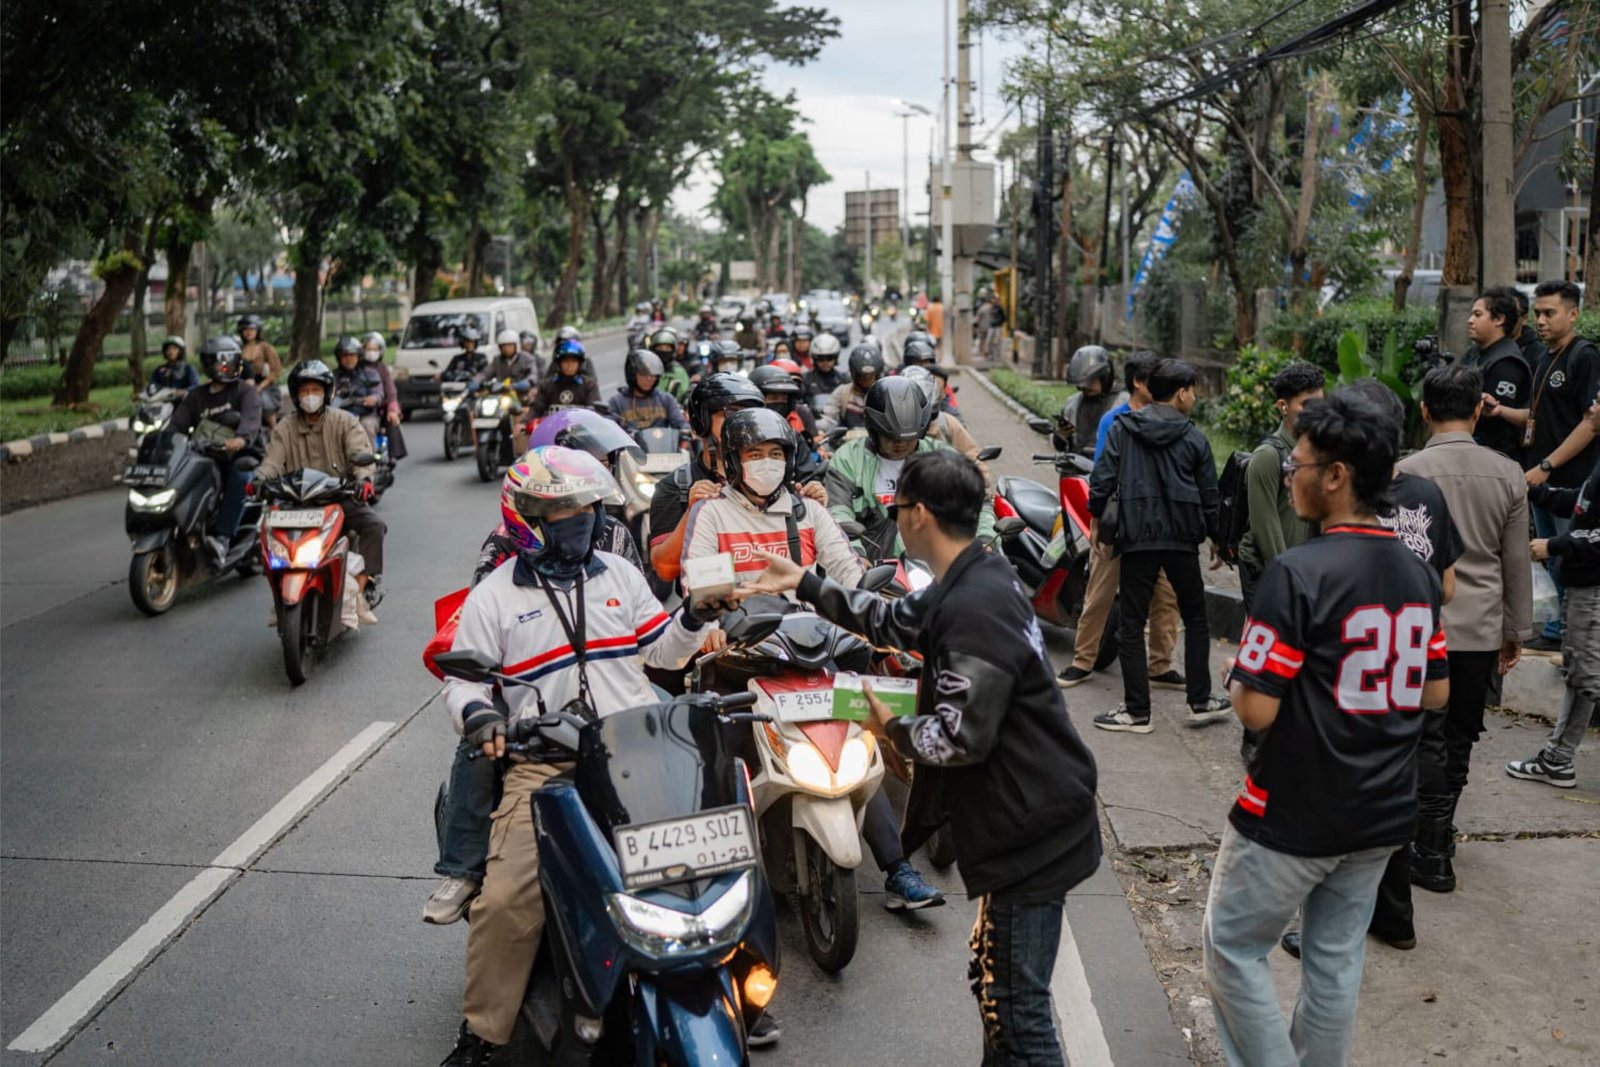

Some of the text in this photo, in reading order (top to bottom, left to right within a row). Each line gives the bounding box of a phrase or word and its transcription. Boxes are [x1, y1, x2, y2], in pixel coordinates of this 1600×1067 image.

[526, 482, 574, 493] LOTUS
[1238, 616, 1280, 674] 8
[1334, 603, 1434, 715] 28
[778, 691, 832, 707] F 2554
[626, 815, 744, 857] B 4429 SUZ
